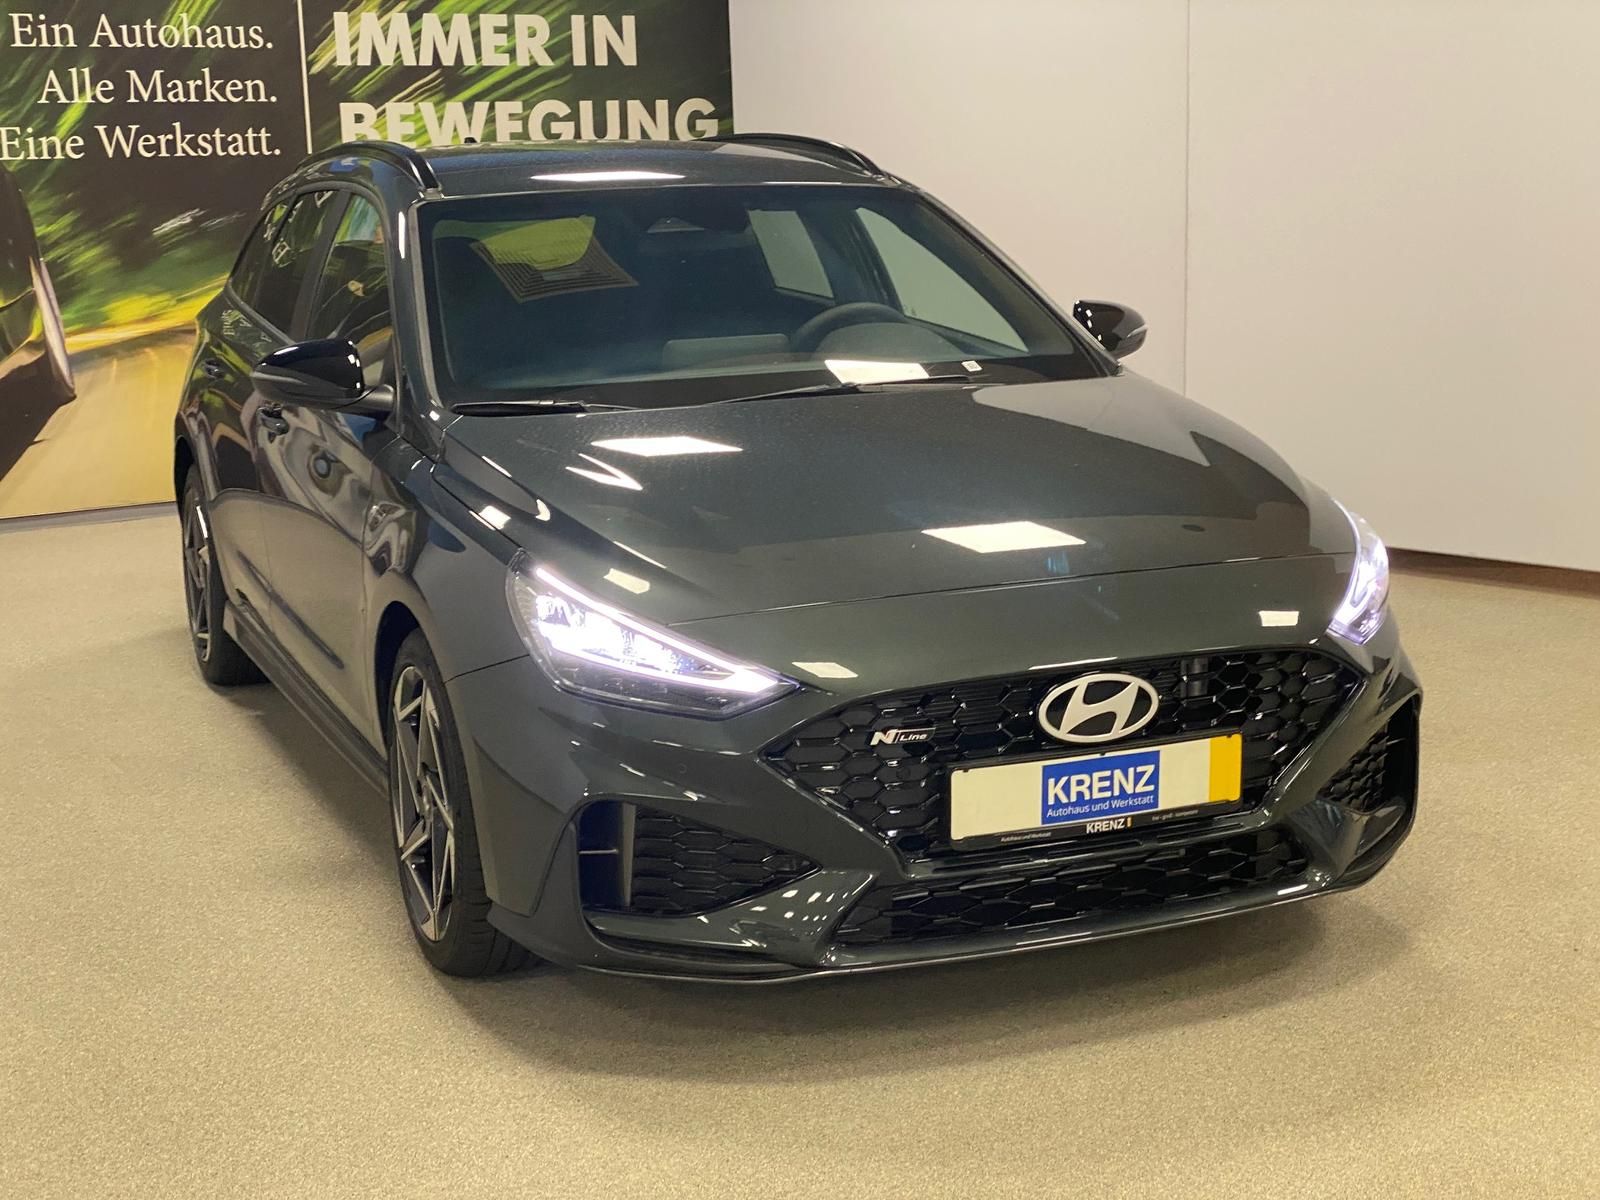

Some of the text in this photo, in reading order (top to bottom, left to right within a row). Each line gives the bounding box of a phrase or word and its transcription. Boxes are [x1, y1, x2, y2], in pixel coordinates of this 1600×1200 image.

[9, 13, 274, 49] Ein Autohaus.
[333, 12, 638, 66] IMMER IN
[37, 67, 278, 104] Alle Marken.
[0, 121, 281, 161] Eine Werkstatt.
[339, 97, 719, 147] BEWEGUNG
[1047, 764, 1156, 805] KRENZ
[1046, 795, 1154, 818] Autohaus und Werkstatt
[1086, 818, 1126, 834] KRENZ
